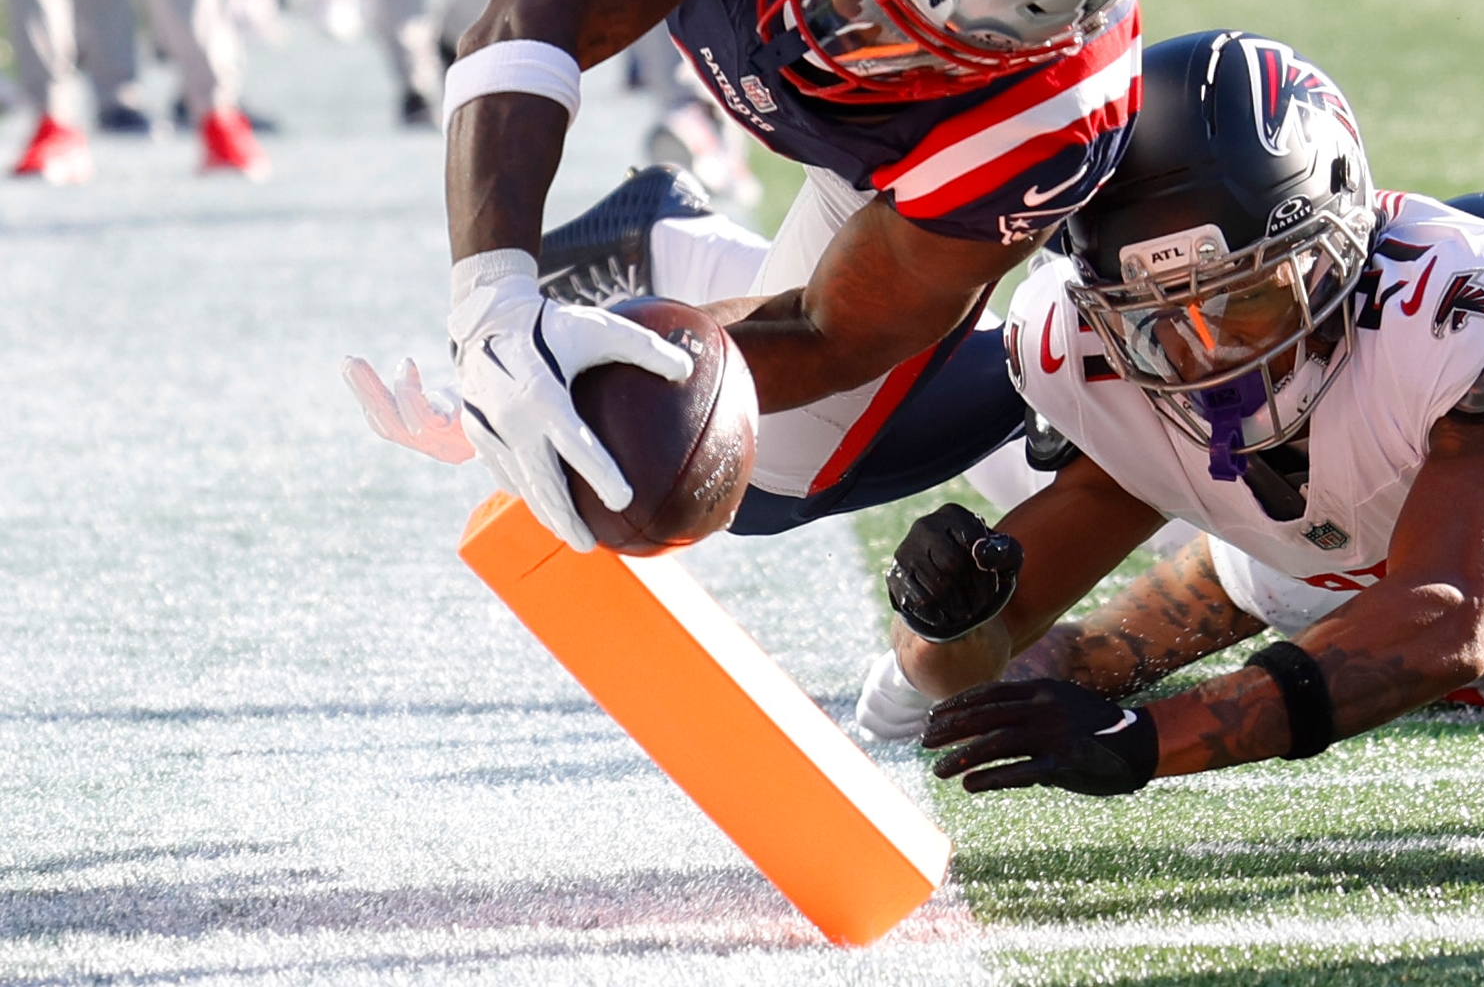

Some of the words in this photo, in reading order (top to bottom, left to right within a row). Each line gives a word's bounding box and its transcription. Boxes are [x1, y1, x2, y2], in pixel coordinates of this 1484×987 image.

[700, 46, 775, 131] PATRIOTS
[1271, 205, 1310, 232] OAKLEY
[1151, 247, 1184, 263] ATL
